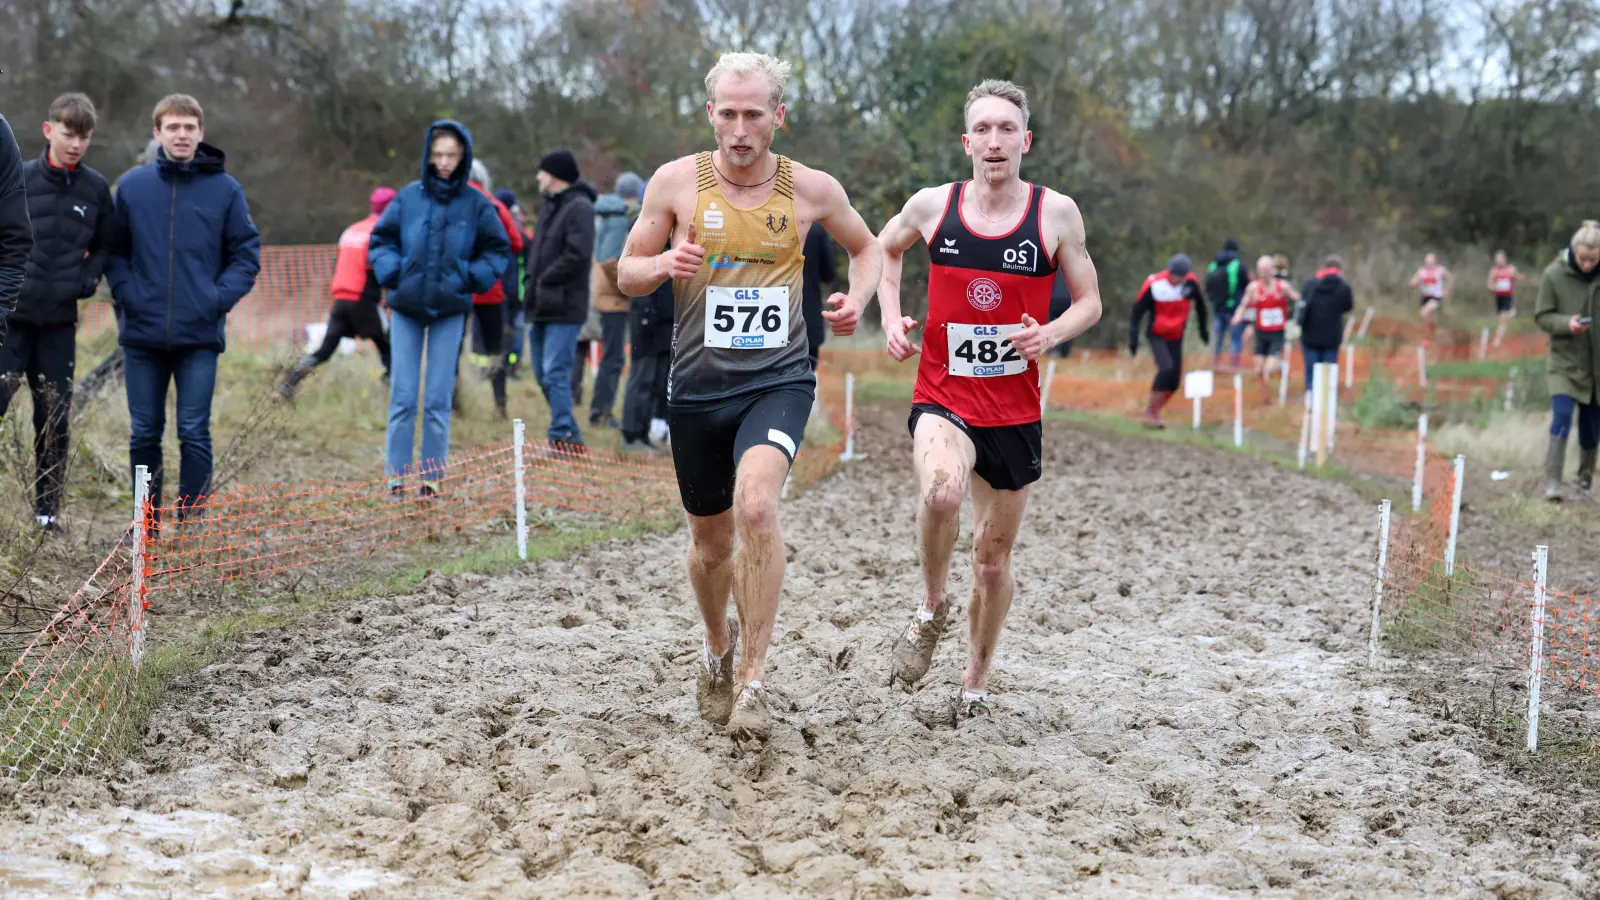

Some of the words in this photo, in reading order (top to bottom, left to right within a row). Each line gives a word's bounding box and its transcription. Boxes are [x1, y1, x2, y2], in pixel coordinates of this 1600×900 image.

[939, 246, 960, 255] erima
[1003, 248, 1028, 265] OS
[734, 256, 760, 264] Bayerische
[759, 257, 776, 265] Polizei
[1002, 262, 1034, 273] BauImmo
[713, 304, 782, 333] 576
[955, 339, 1022, 364] 482
